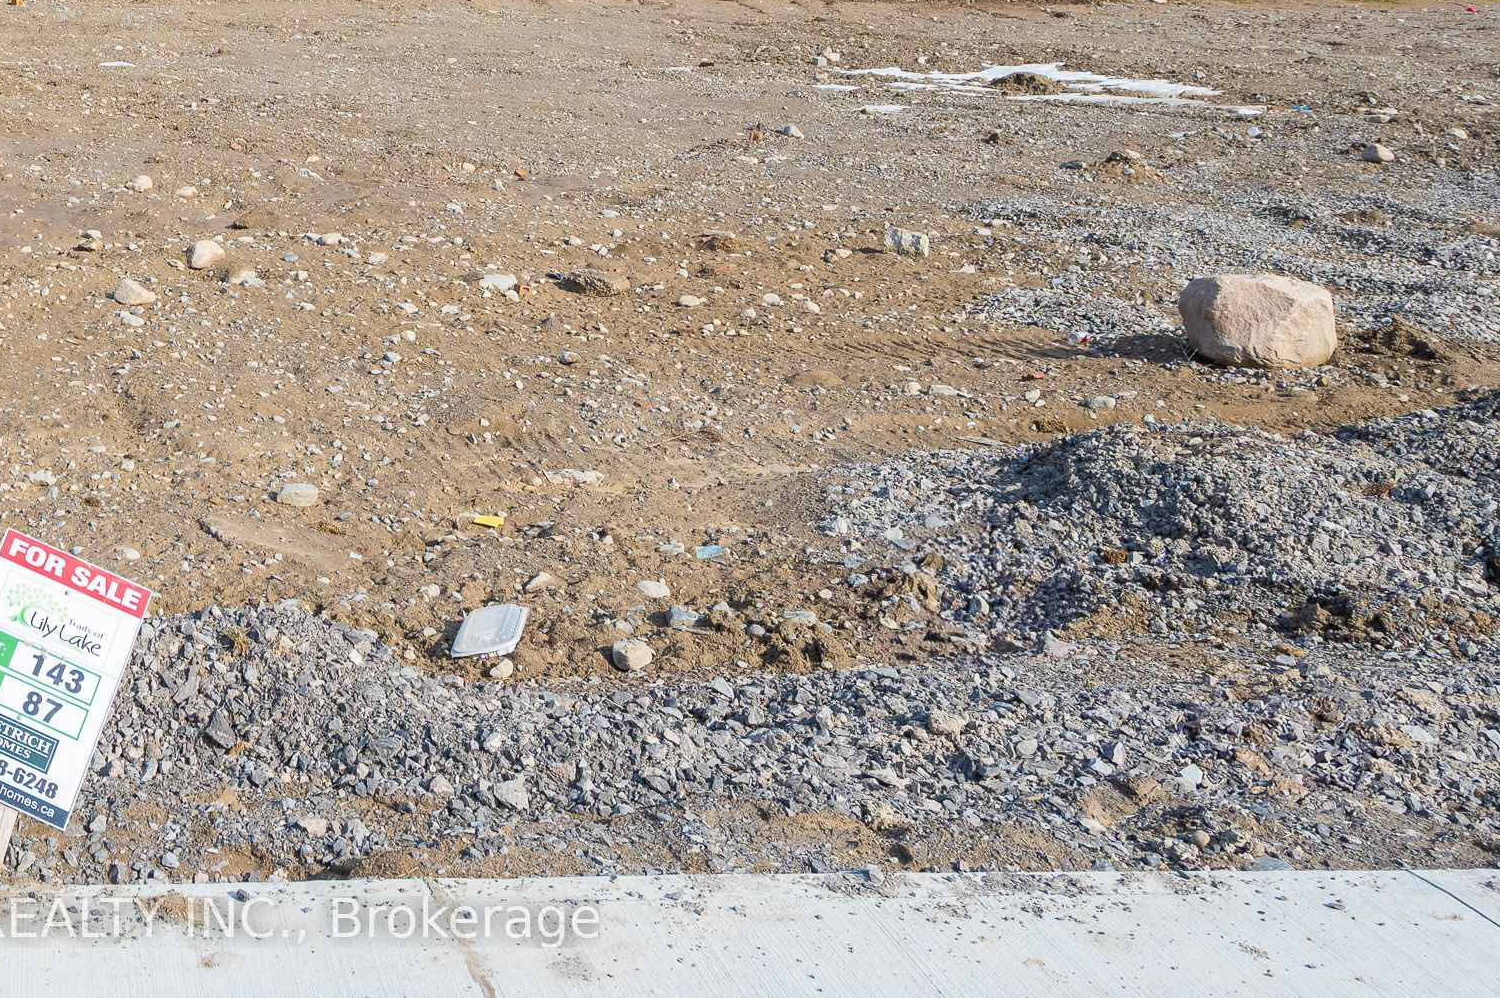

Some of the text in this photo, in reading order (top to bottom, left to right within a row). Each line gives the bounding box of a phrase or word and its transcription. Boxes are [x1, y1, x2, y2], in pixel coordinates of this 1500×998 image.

[8, 537, 142, 611] FOR SALE
[30, 611, 102, 657] Lily Lake
[31, 653, 86, 694] 143
[22, 691, 63, 724] 87
